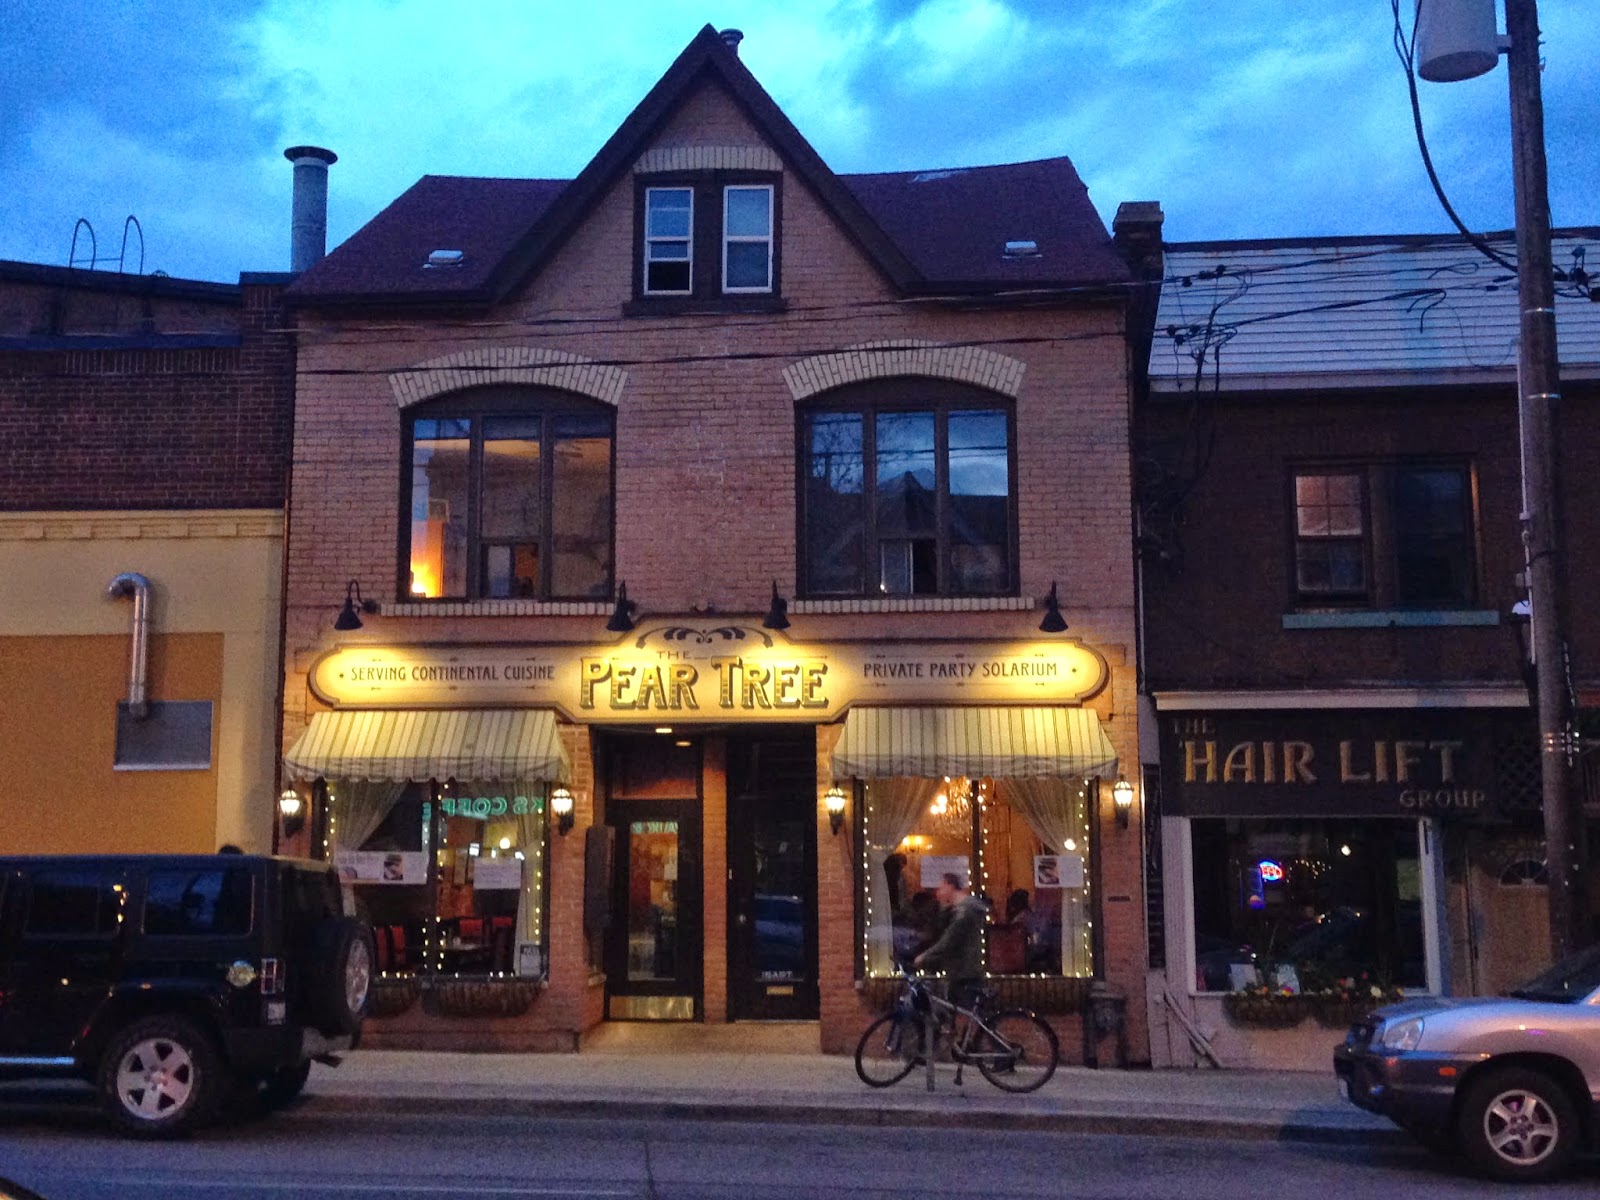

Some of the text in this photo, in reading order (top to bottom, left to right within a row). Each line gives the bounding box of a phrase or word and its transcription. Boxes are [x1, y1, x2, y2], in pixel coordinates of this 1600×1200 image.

[656, 650, 692, 660] THE
[350, 665, 555, 682] SERVING CONTINENTAL CUISINE
[863, 661, 1058, 679] PRIVATE PARTY SOLARIUM
[580, 655, 830, 711] PEAR TREE
[1173, 717, 1216, 735] THE
[1184, 740, 1464, 784] HAIR LIFT
[1400, 788, 1486, 809] GROUP
